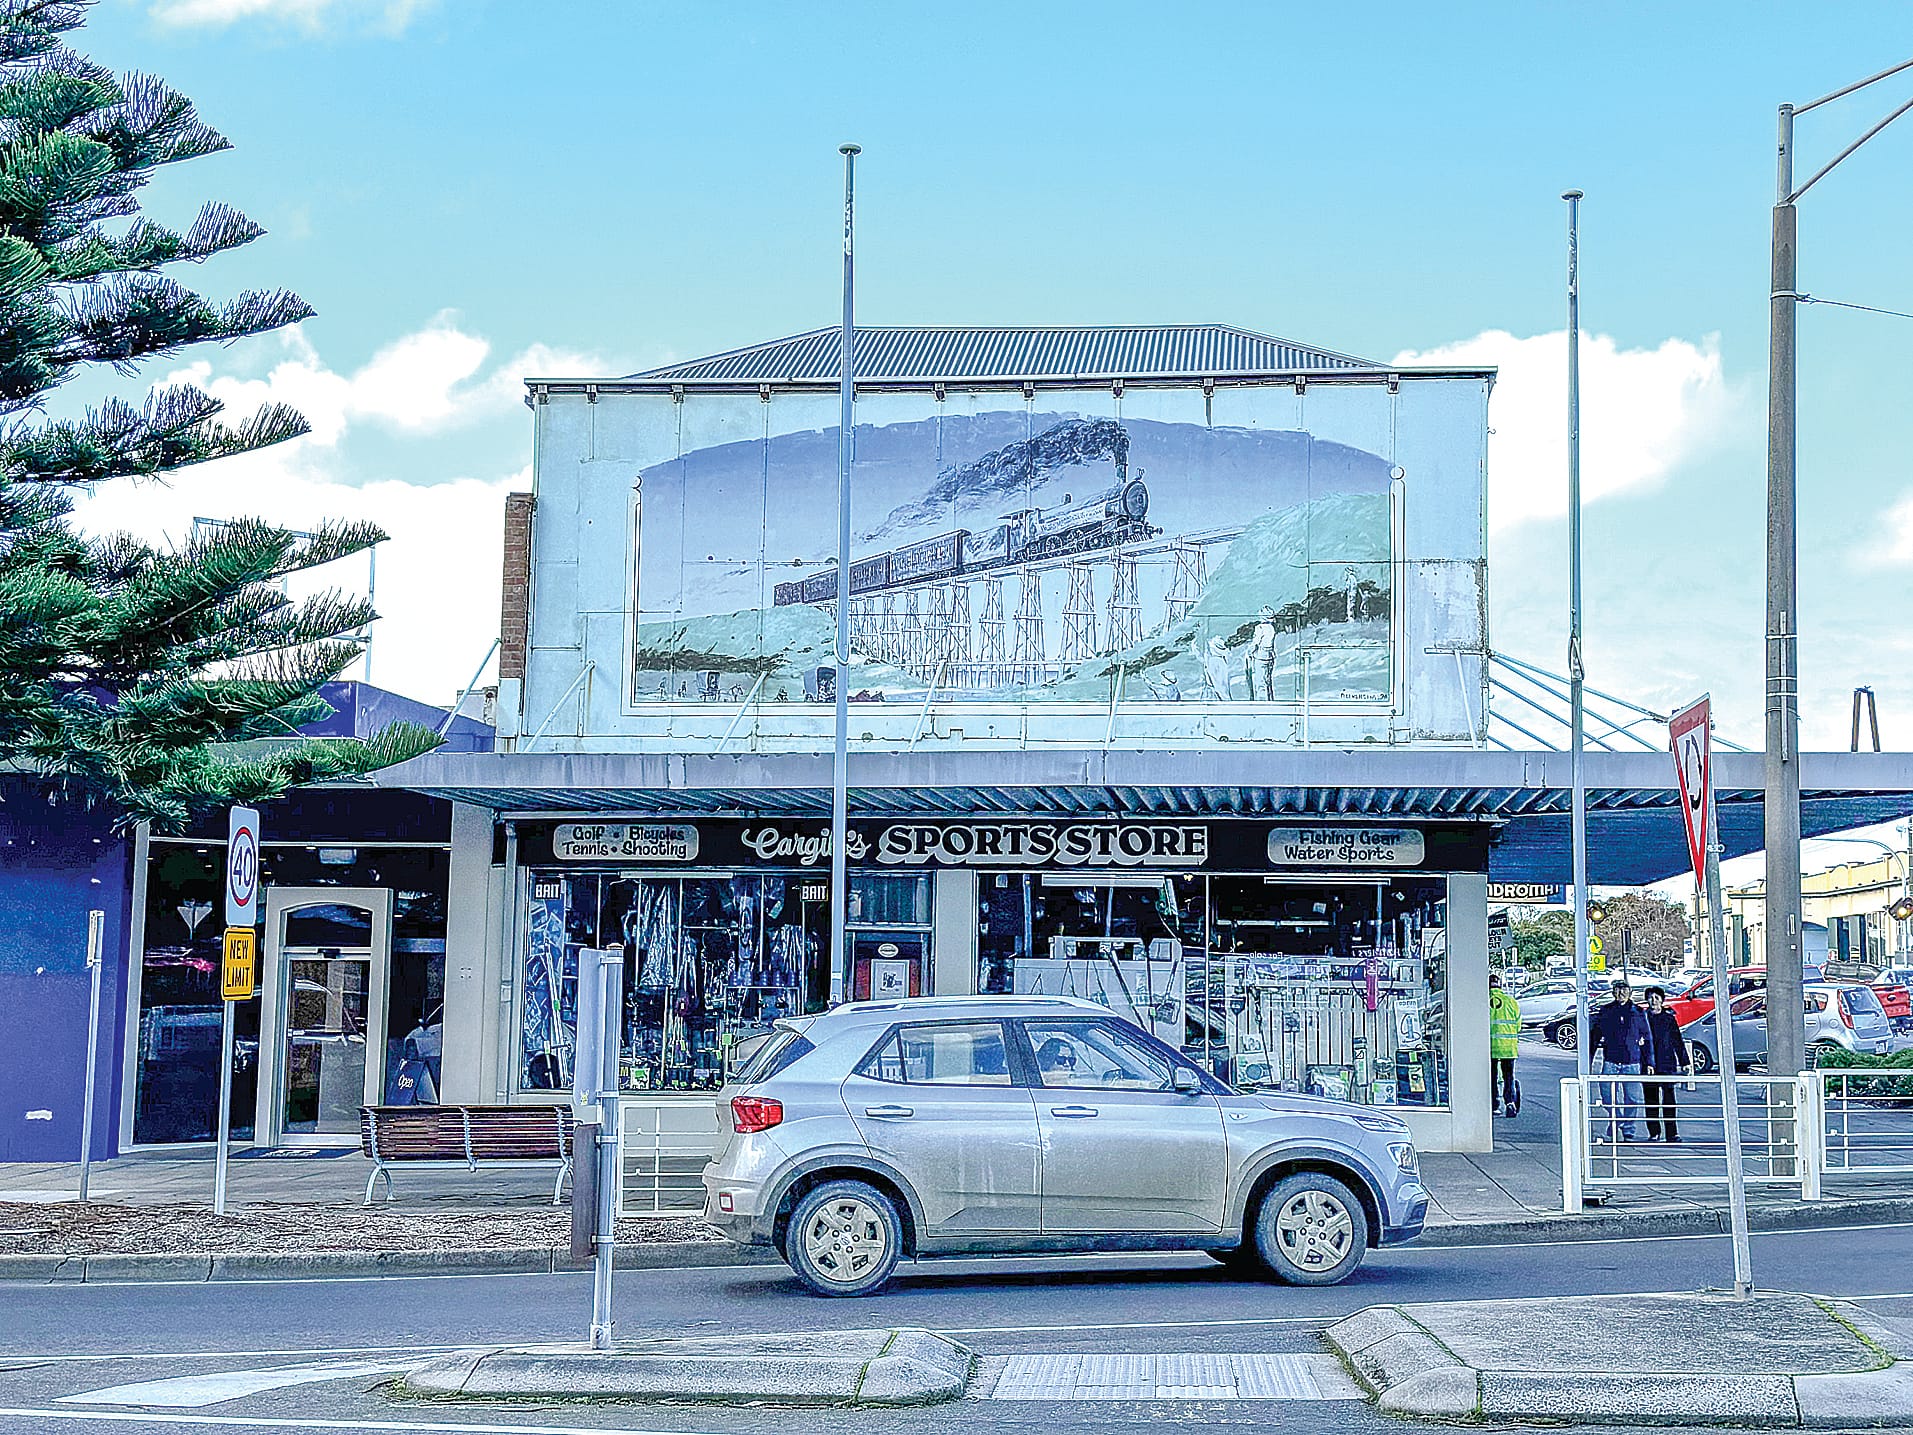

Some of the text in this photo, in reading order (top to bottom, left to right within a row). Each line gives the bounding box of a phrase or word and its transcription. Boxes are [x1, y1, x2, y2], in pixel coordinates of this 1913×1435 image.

[572, 826, 685, 842] Golf Bicycles
[1299, 829, 1400, 848] Fishing Gear
[562, 841, 687, 859] Tennis Shooting
[877, 825, 1056, 864] SPORTS
[1054, 825, 1208, 865] STORE
[1284, 846, 1395, 863] Water Sports
[231, 847, 254, 888] 40
[535, 883, 561, 899] BAIT
[801, 885, 827, 901] BAIT
[229, 940, 249, 960] NEW
[225, 967, 251, 989] LIMIT
